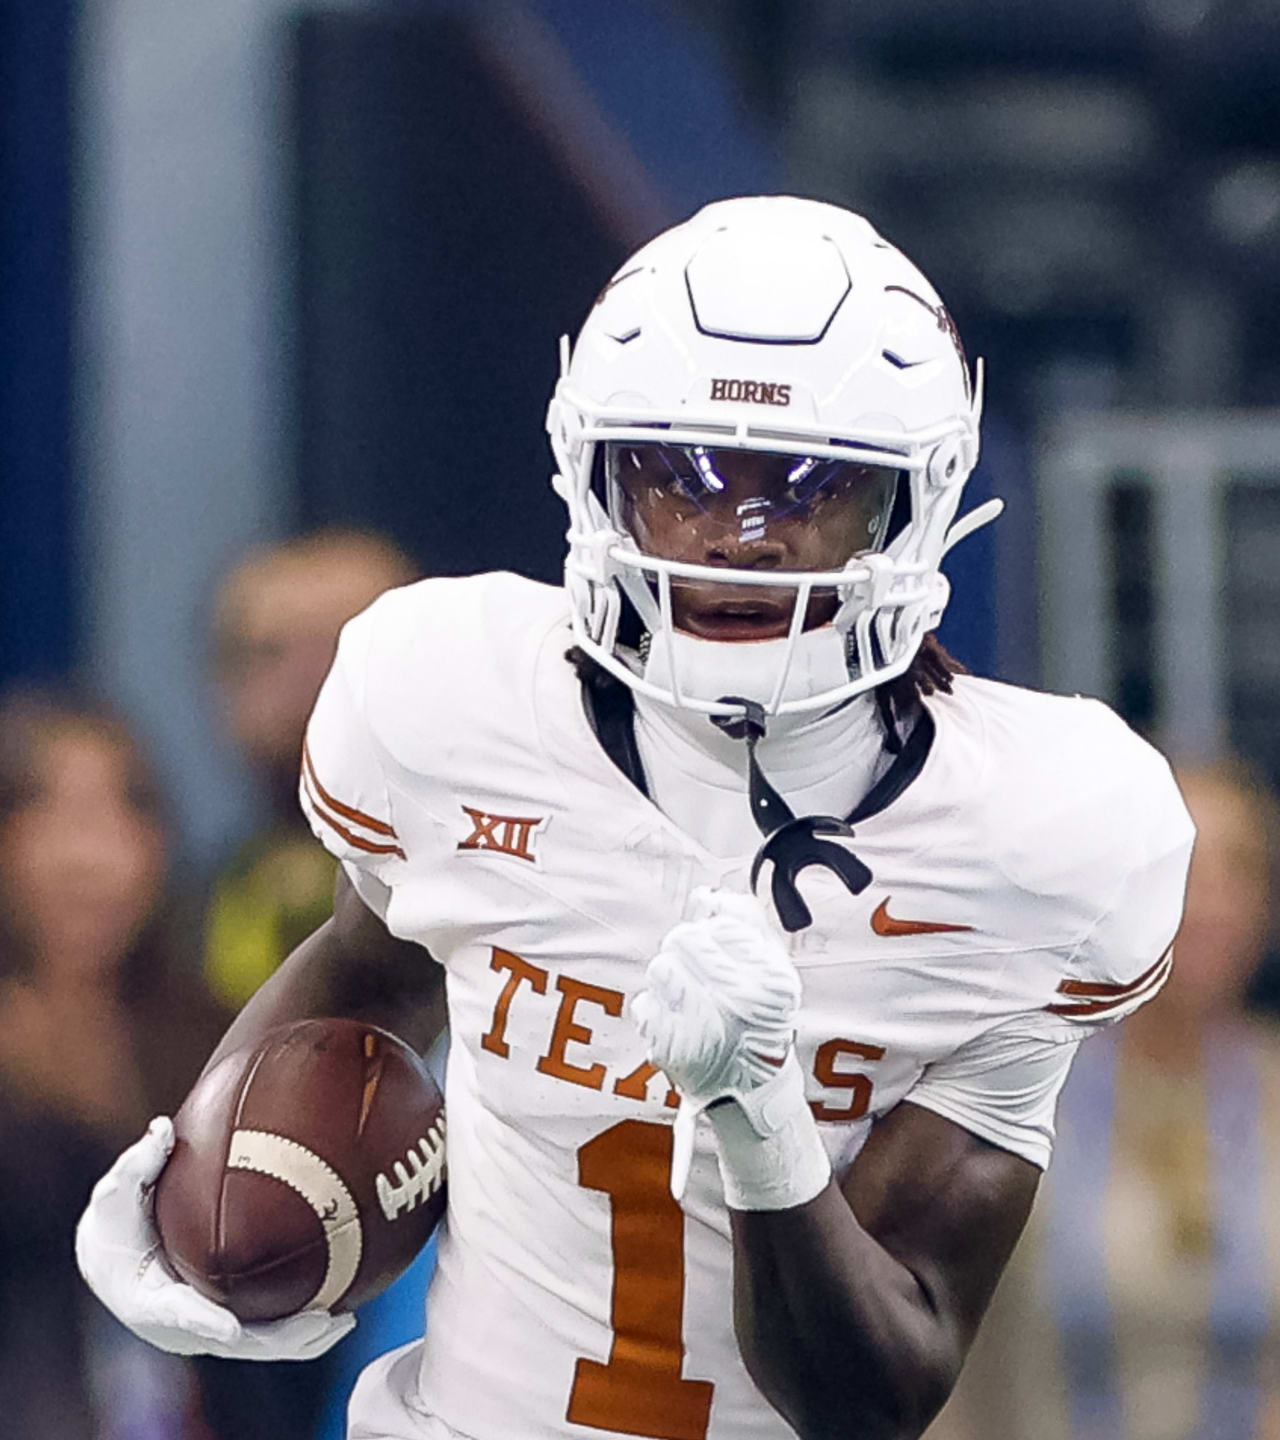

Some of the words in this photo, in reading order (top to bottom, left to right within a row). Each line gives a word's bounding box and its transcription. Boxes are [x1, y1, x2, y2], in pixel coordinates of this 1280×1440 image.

[710, 378, 791, 407] HORNS
[457, 804, 544, 863] XII
[481, 946, 886, 1123] TES
